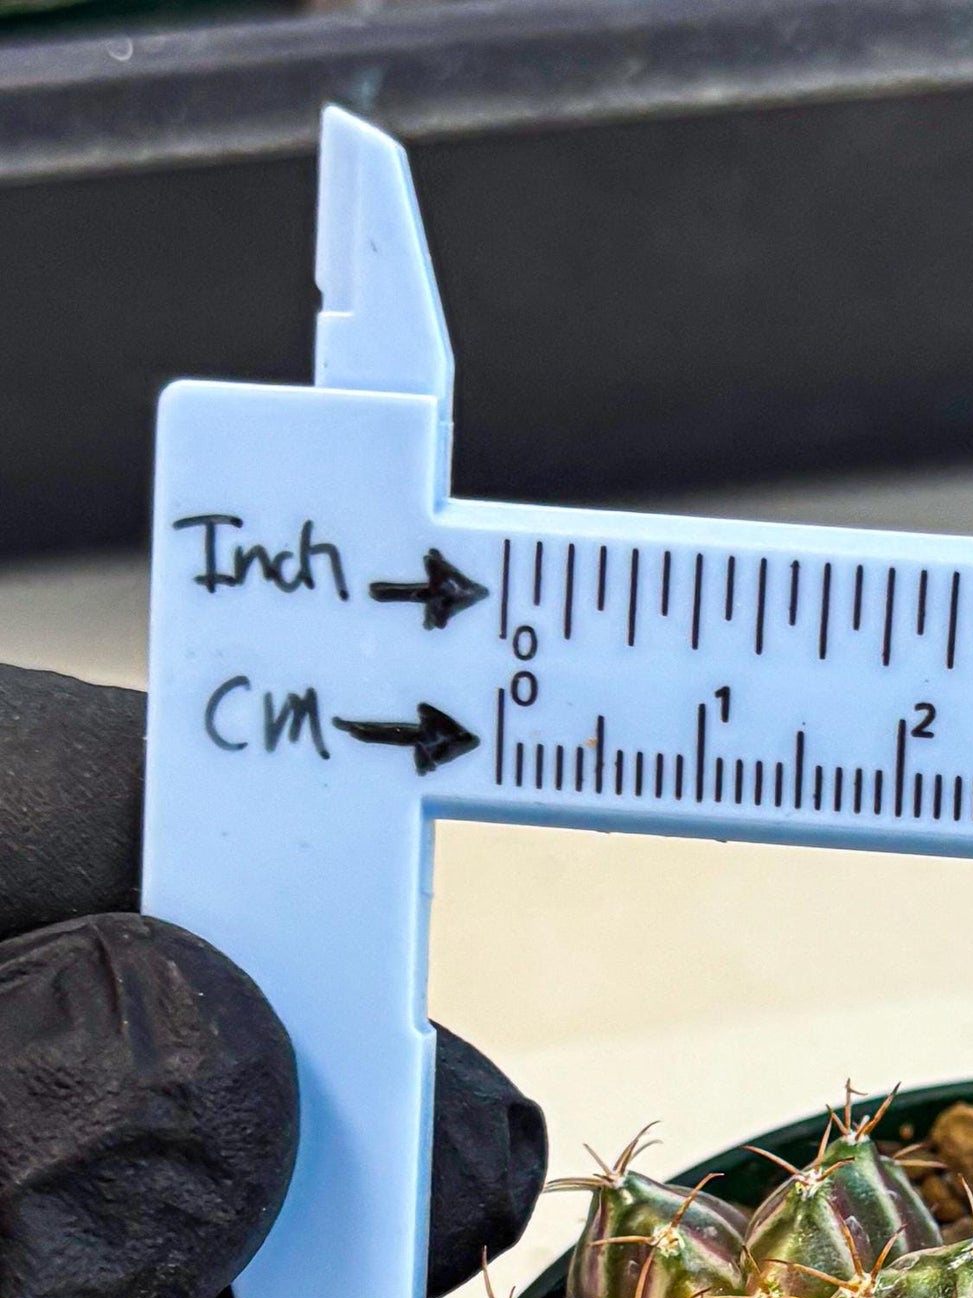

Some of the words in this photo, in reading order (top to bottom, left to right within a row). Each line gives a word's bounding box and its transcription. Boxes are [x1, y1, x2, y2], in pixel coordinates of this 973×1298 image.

[172, 513, 350, 602] Inch
[512, 624, 539, 662] 0
[509, 670, 539, 708] 0
[714, 685, 731, 724] 1
[910, 701, 937, 739] 2
